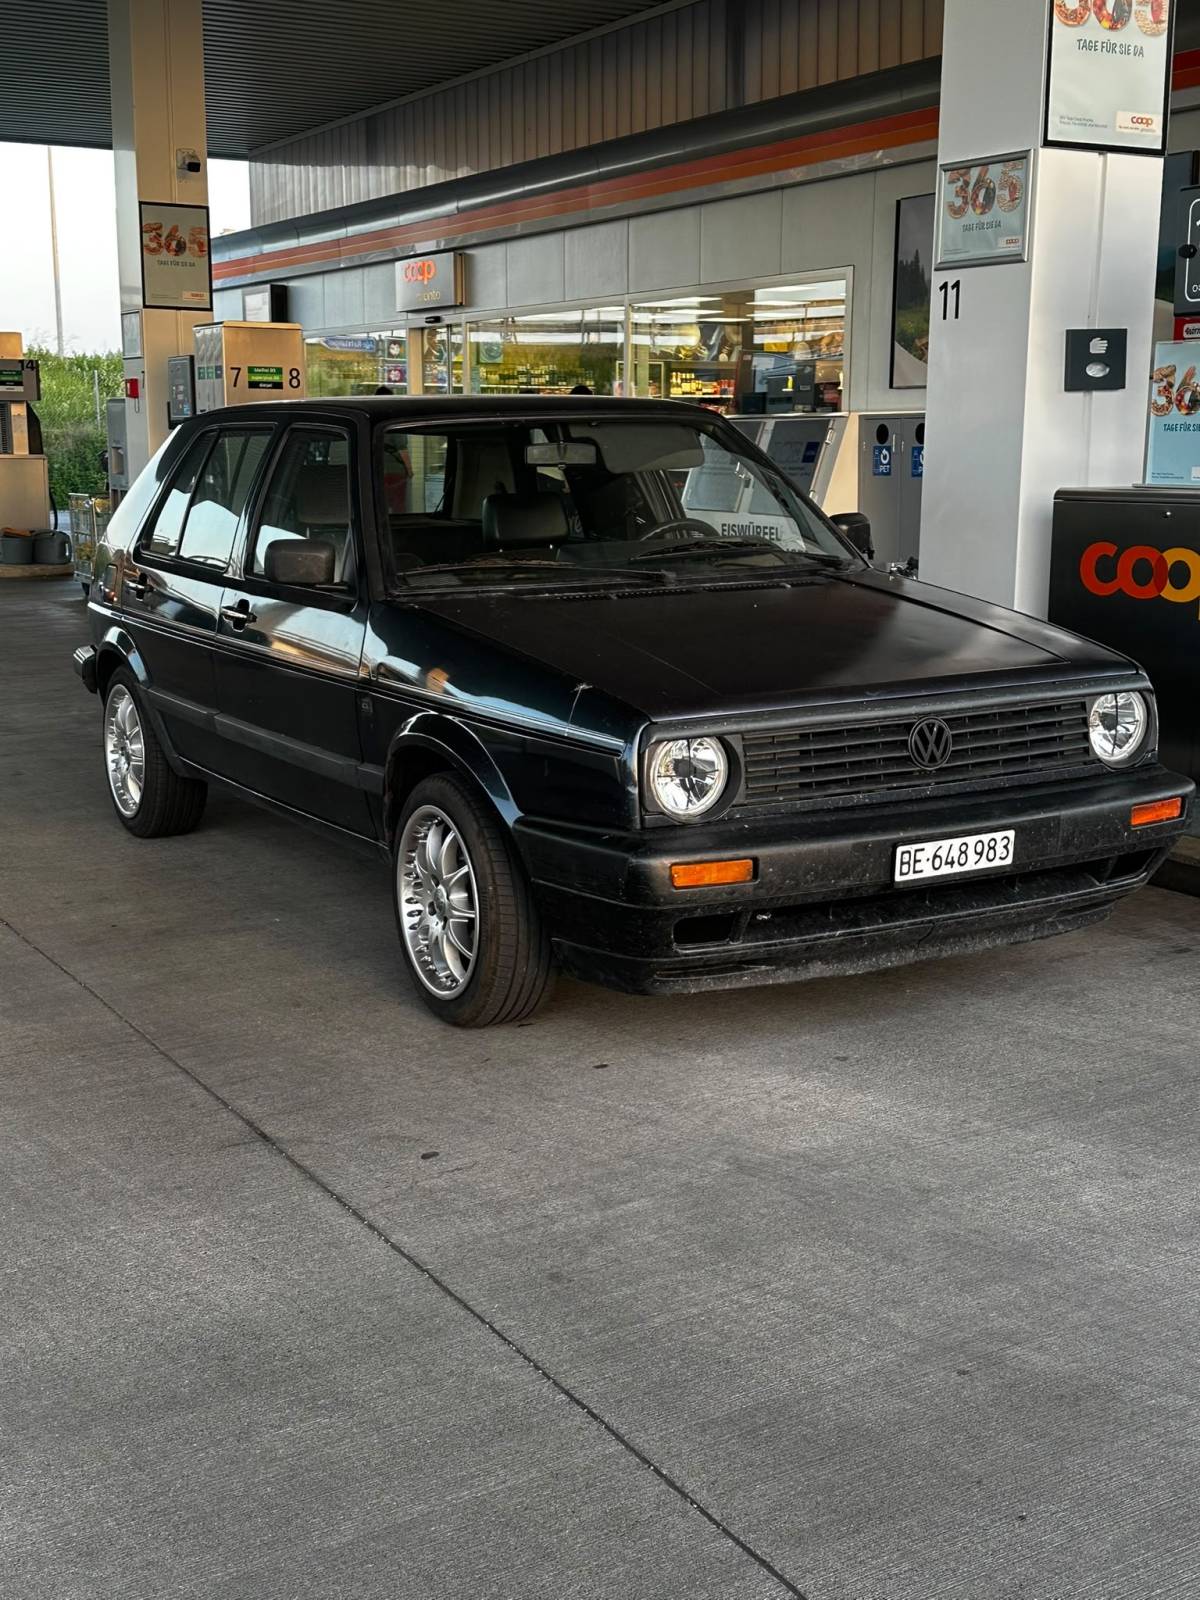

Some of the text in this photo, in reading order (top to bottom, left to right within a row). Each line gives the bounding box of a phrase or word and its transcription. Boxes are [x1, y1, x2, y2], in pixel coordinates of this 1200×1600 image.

[1077, 39, 1144, 58] TAGE FÜR SIE DA
[1131, 115, 1153, 127] coop
[947, 162, 1023, 219] 365
[143, 222, 207, 258] 365
[938, 280, 960, 320] 11
[18, 359, 36, 371] 14
[230, 367, 241, 388] 7
[289, 368, 300, 388] 8
[1163, 423, 1179, 432] TAGE
[1180, 421, 1191, 432] FÜR
[880, 465, 890, 473] PET
[721, 521, 781, 541] EISWÜRFEL
[1080, 541, 1200, 621] coo
